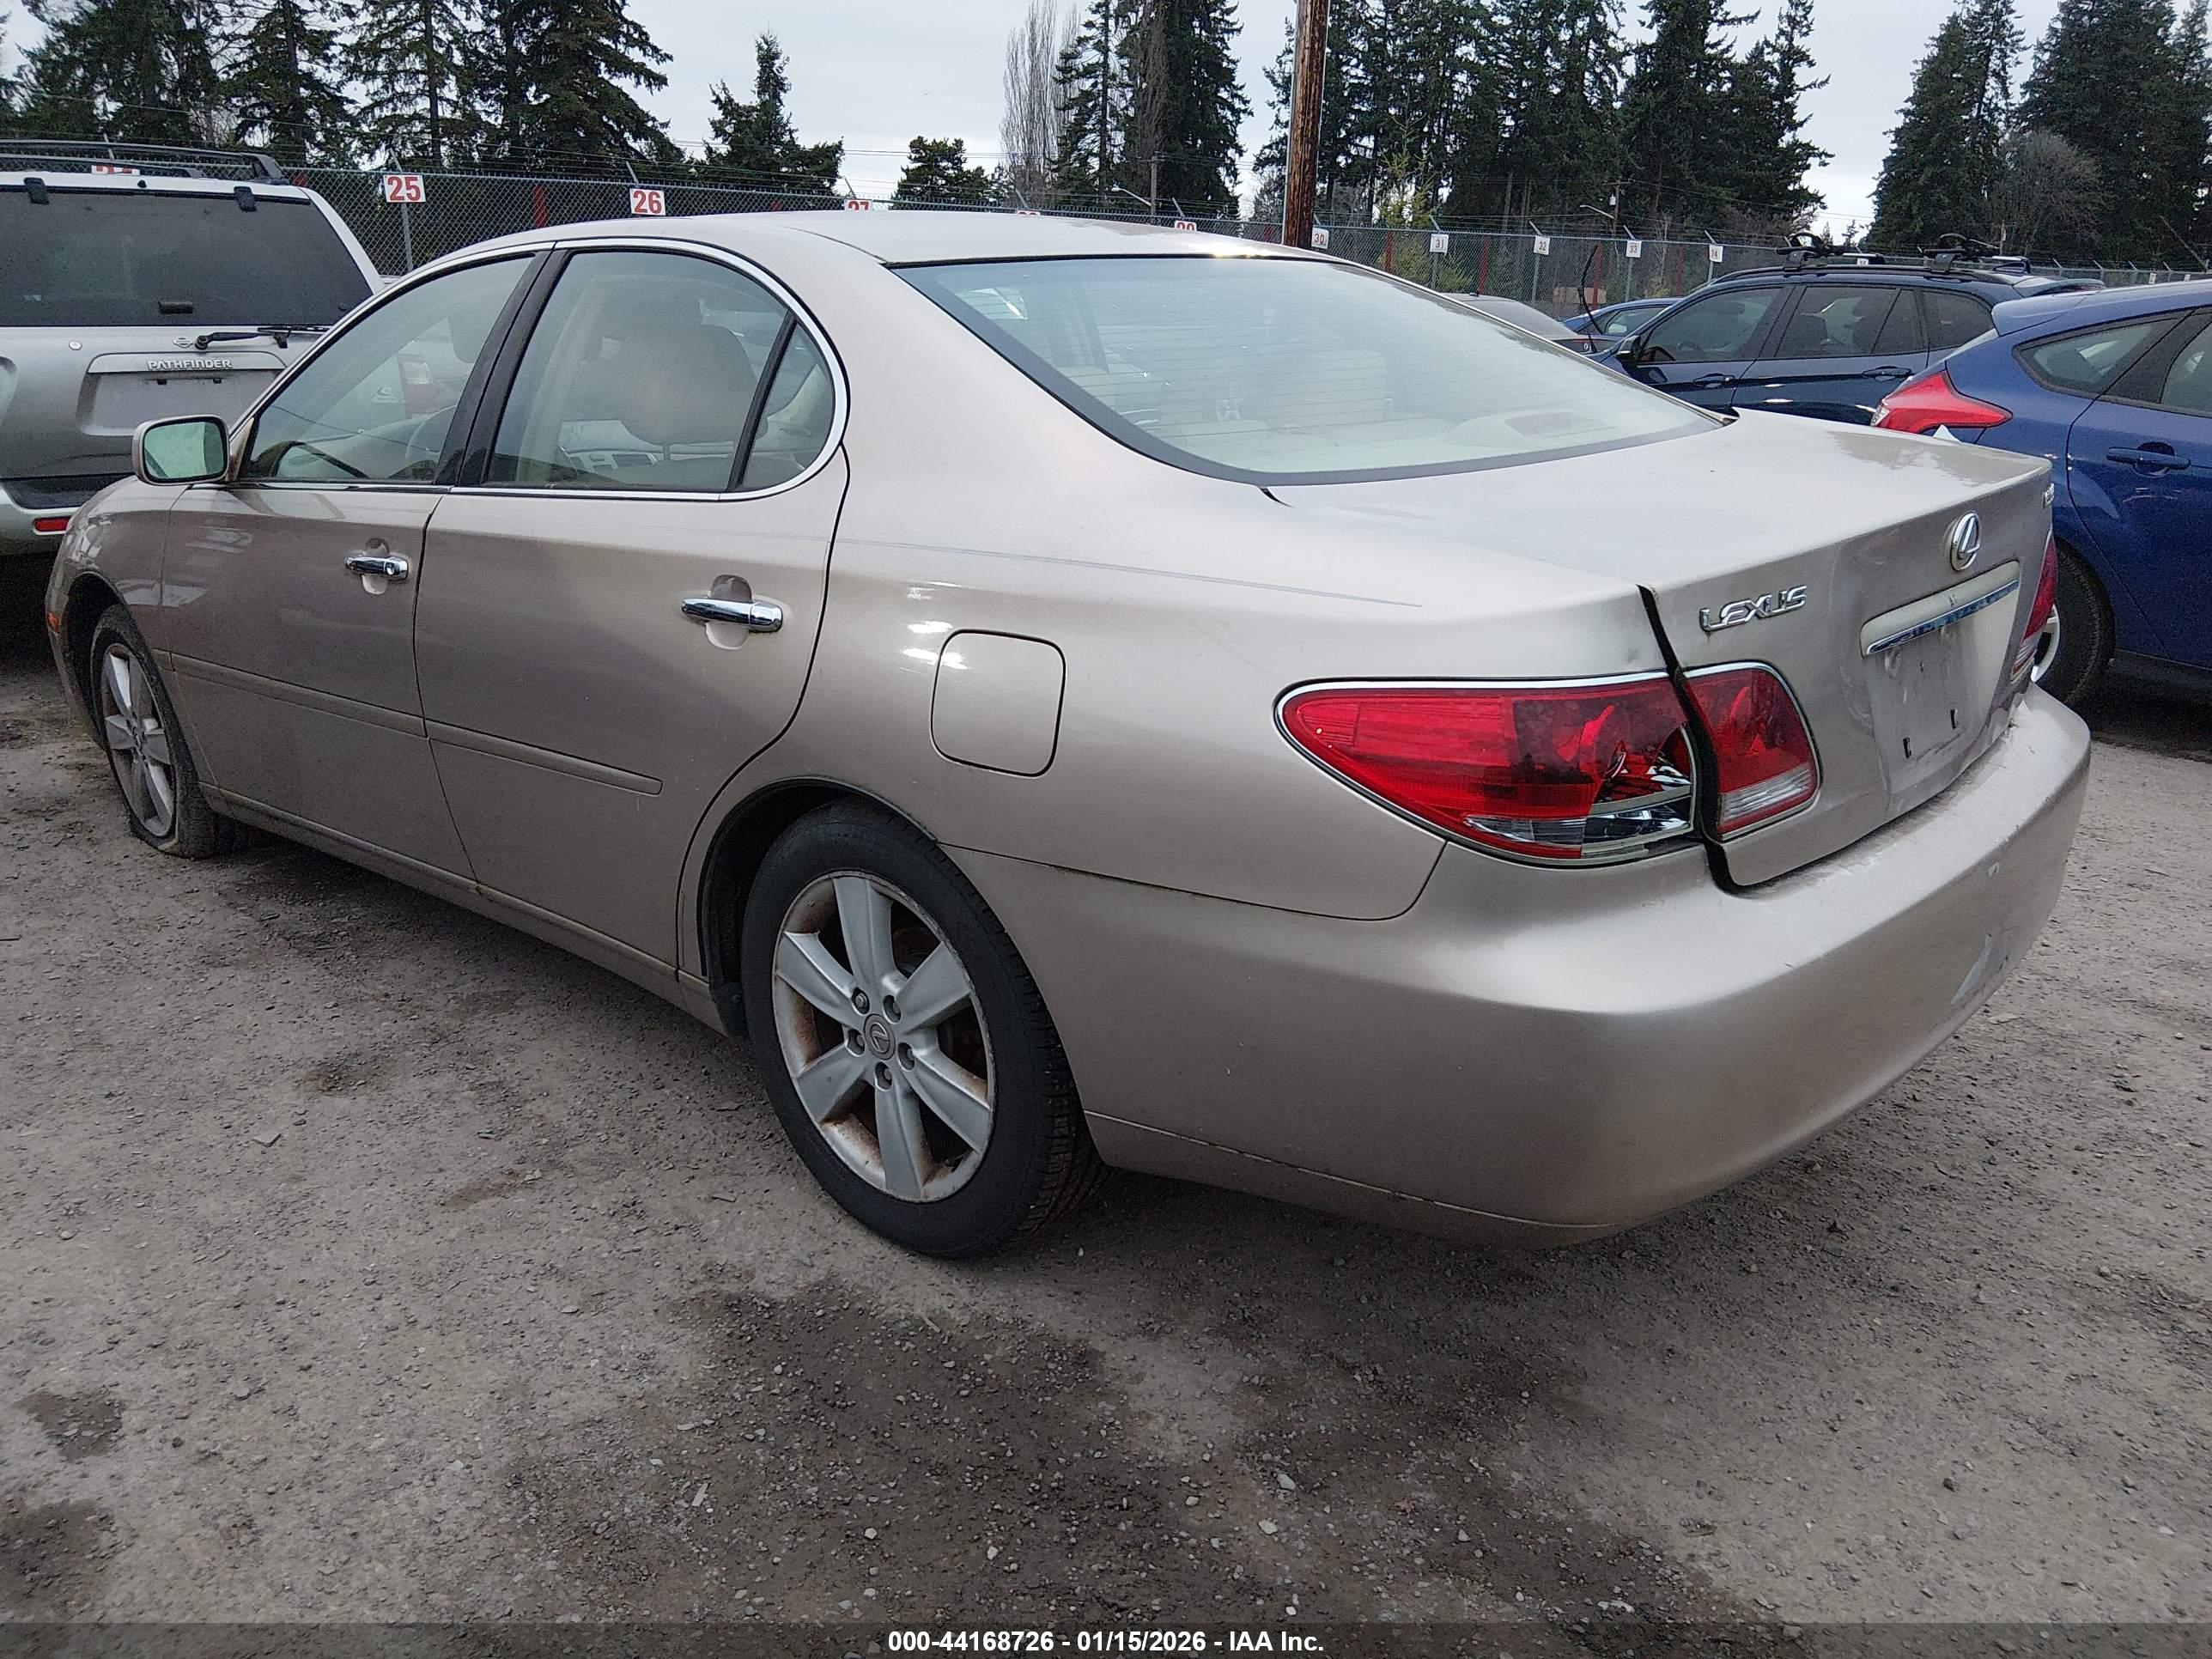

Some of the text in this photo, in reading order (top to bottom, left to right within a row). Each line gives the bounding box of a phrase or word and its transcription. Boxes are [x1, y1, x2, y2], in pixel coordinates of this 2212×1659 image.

[387, 176, 421, 201] 25
[633, 190, 662, 214] 26
[1314, 233, 1325, 244] 30
[1435, 239, 1444, 249] 31
[148, 359, 234, 370] PATHFINDER
[1699, 582, 1808, 633] LEXUS
